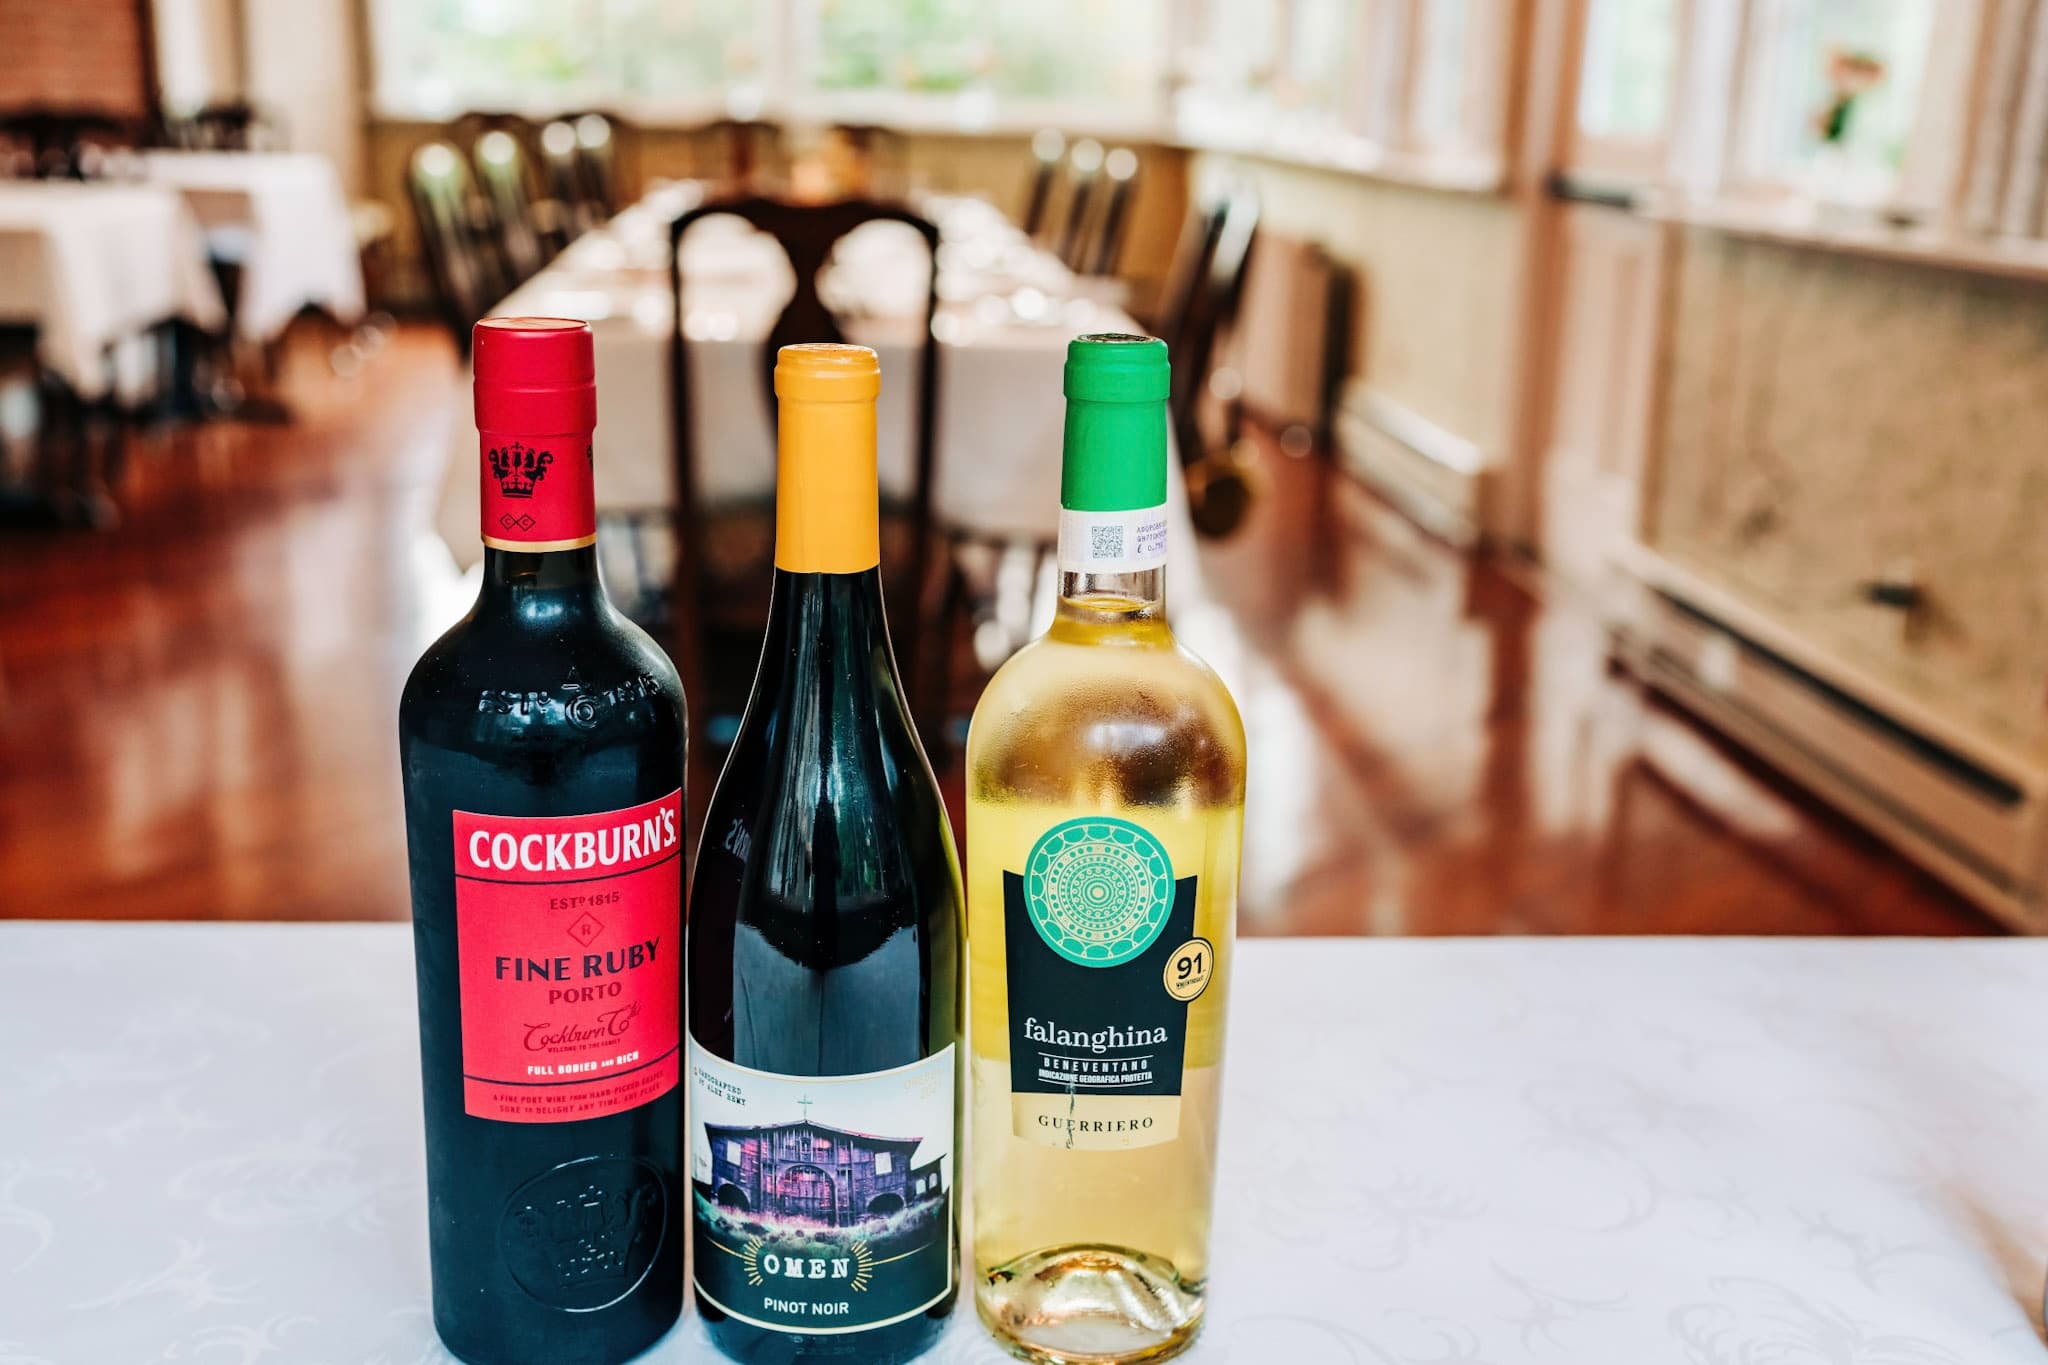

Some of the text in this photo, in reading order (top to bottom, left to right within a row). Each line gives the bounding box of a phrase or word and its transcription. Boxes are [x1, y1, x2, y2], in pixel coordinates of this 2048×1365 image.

[588, 891, 620, 906] 1815
[496, 936, 661, 982] FINE RUBY
[1177, 952, 1202, 980] 91
[549, 981, 622, 1004] PORTO
[523, 1022, 605, 1051] Cockburn
[1023, 1017, 1168, 1053] falanghina
[527, 1050, 640, 1076] FULL BODIED AND RICH
[1043, 1056, 1148, 1073] BENEVENTANO
[1038, 1068, 1153, 1084] INDICAZIONE GEOGRAFICA PROTETTA
[1038, 1114, 1153, 1132] GUERRIERO
[763, 1254, 850, 1279] OMEN
[764, 1296, 849, 1315] PINOT NOIR
